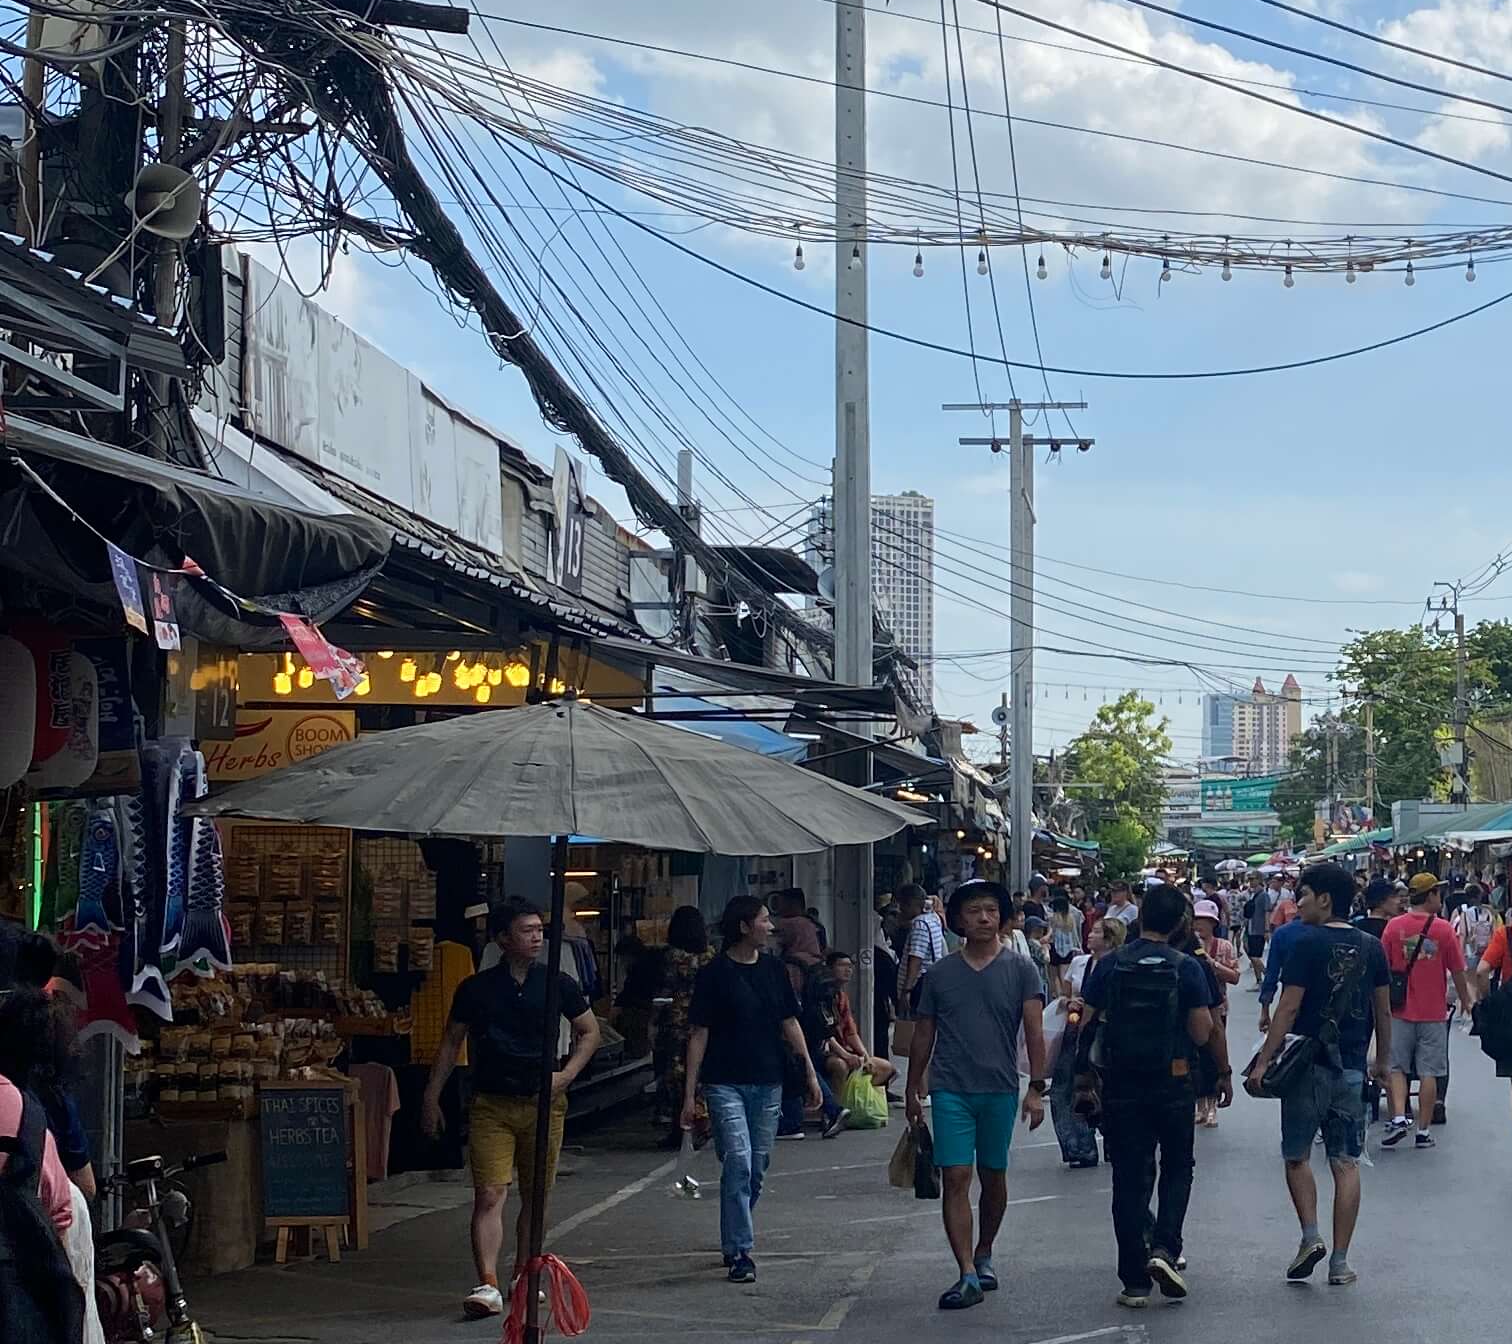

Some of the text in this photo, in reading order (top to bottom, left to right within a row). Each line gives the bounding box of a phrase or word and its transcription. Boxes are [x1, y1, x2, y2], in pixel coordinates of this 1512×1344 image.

[567, 517, 581, 578] 13
[213, 687, 229, 727] 12
[296, 728, 344, 742] BOOM
[208, 743, 282, 773] Herbs
[295, 744, 329, 757] SHO
[261, 1096, 340, 1114] THAI SPICES
[269, 1127, 340, 1145] HERBS TEA
